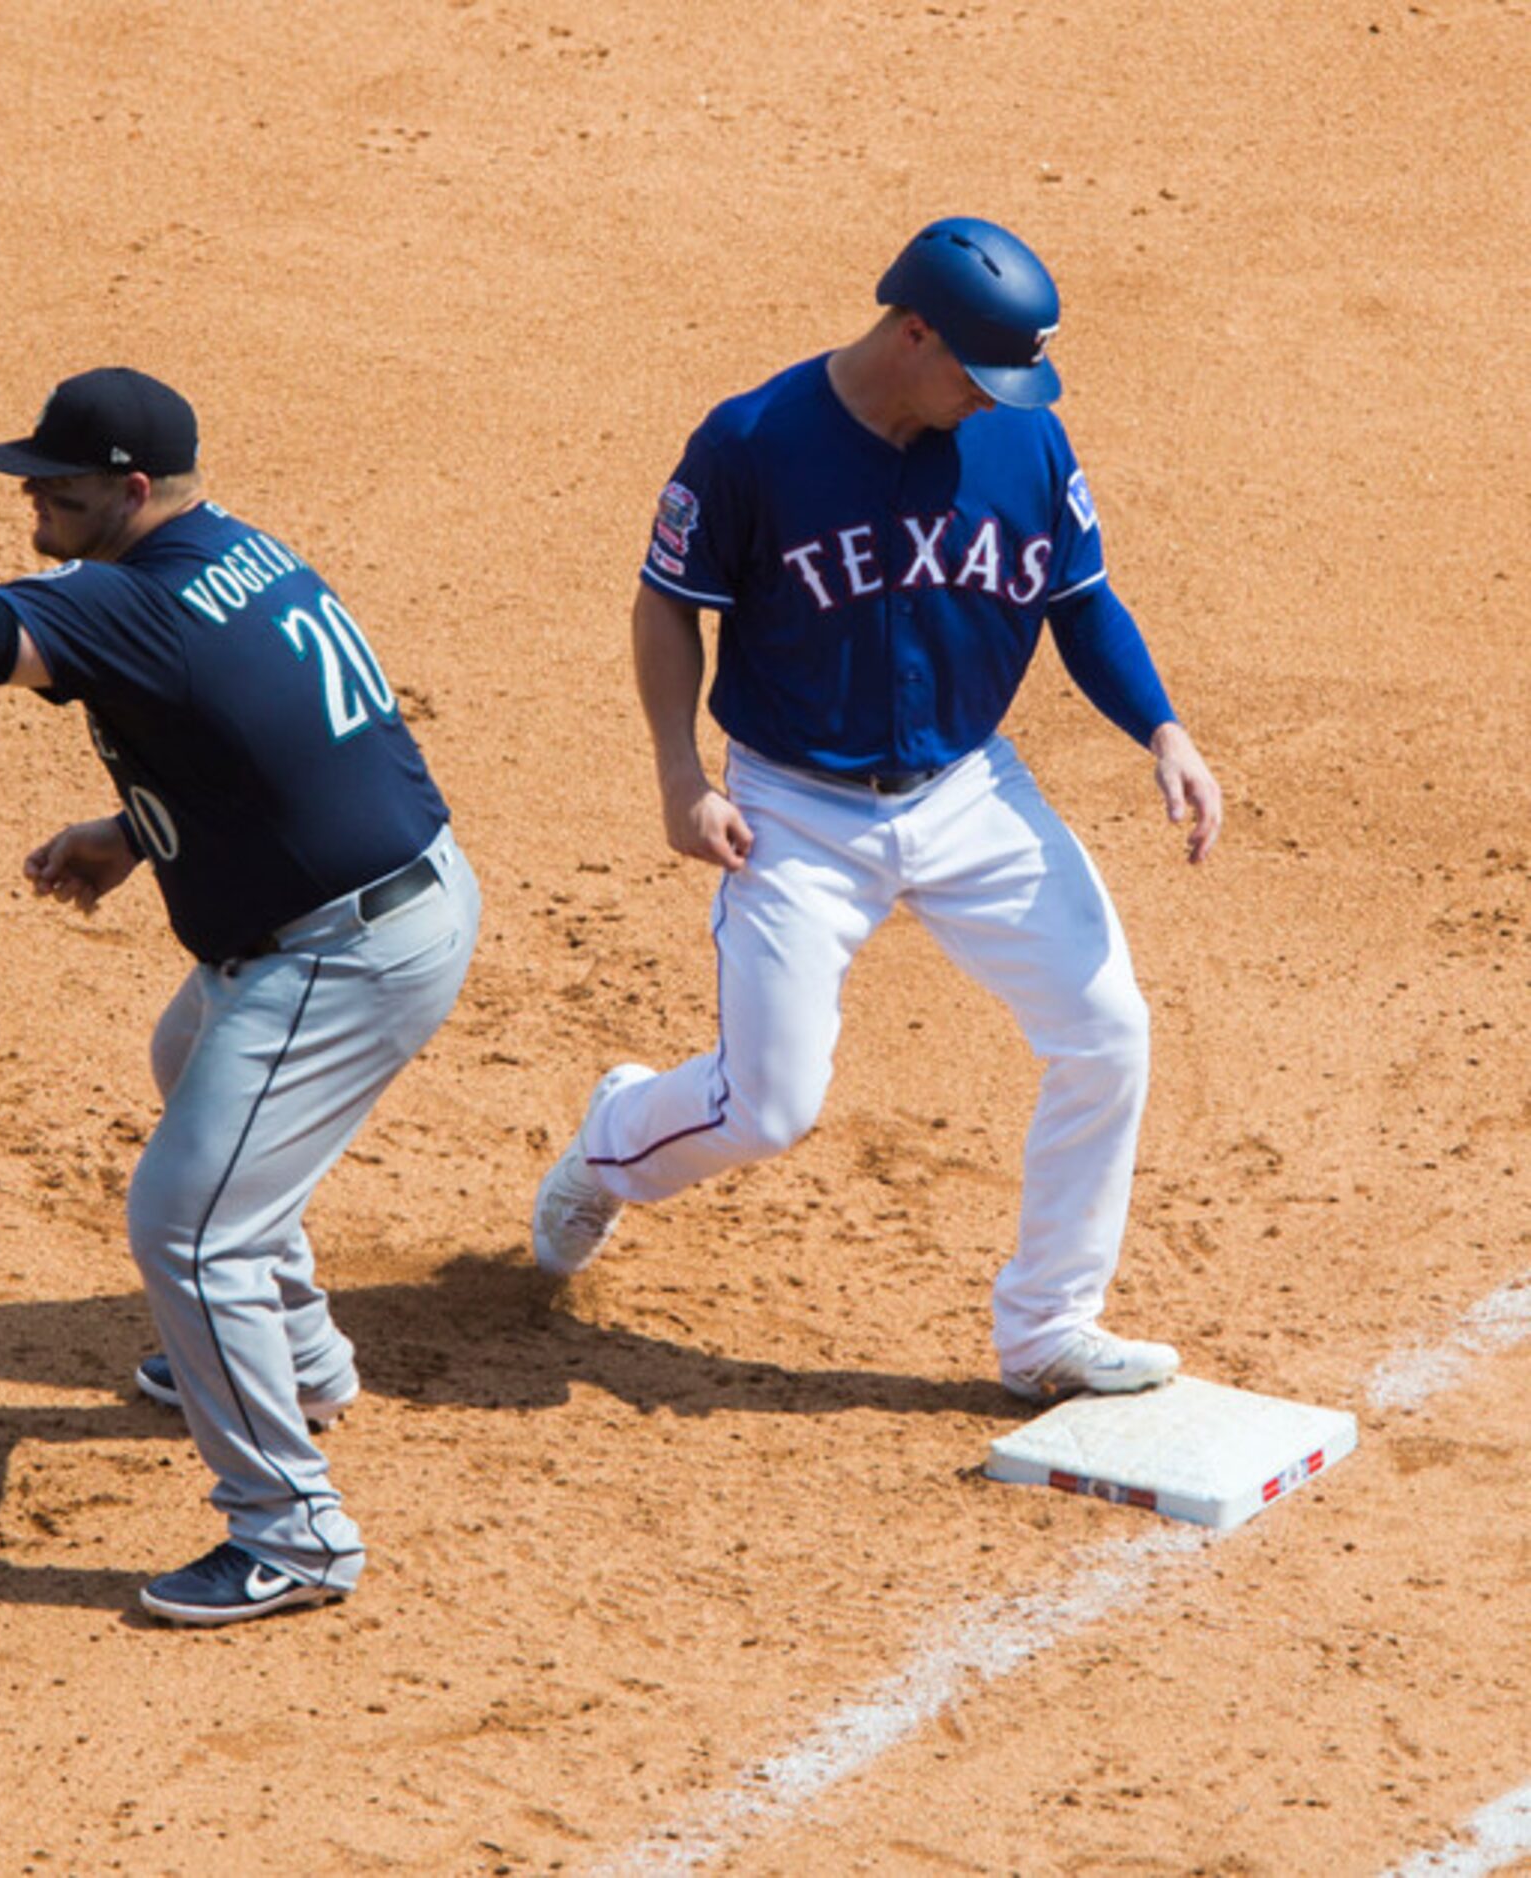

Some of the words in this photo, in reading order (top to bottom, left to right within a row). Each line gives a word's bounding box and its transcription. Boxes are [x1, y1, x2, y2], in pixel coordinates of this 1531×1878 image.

[179, 532, 307, 625] VOGEL
[781, 513, 1054, 610] TEXAS
[273, 588, 399, 744] 20
[124, 785, 179, 862] 0
